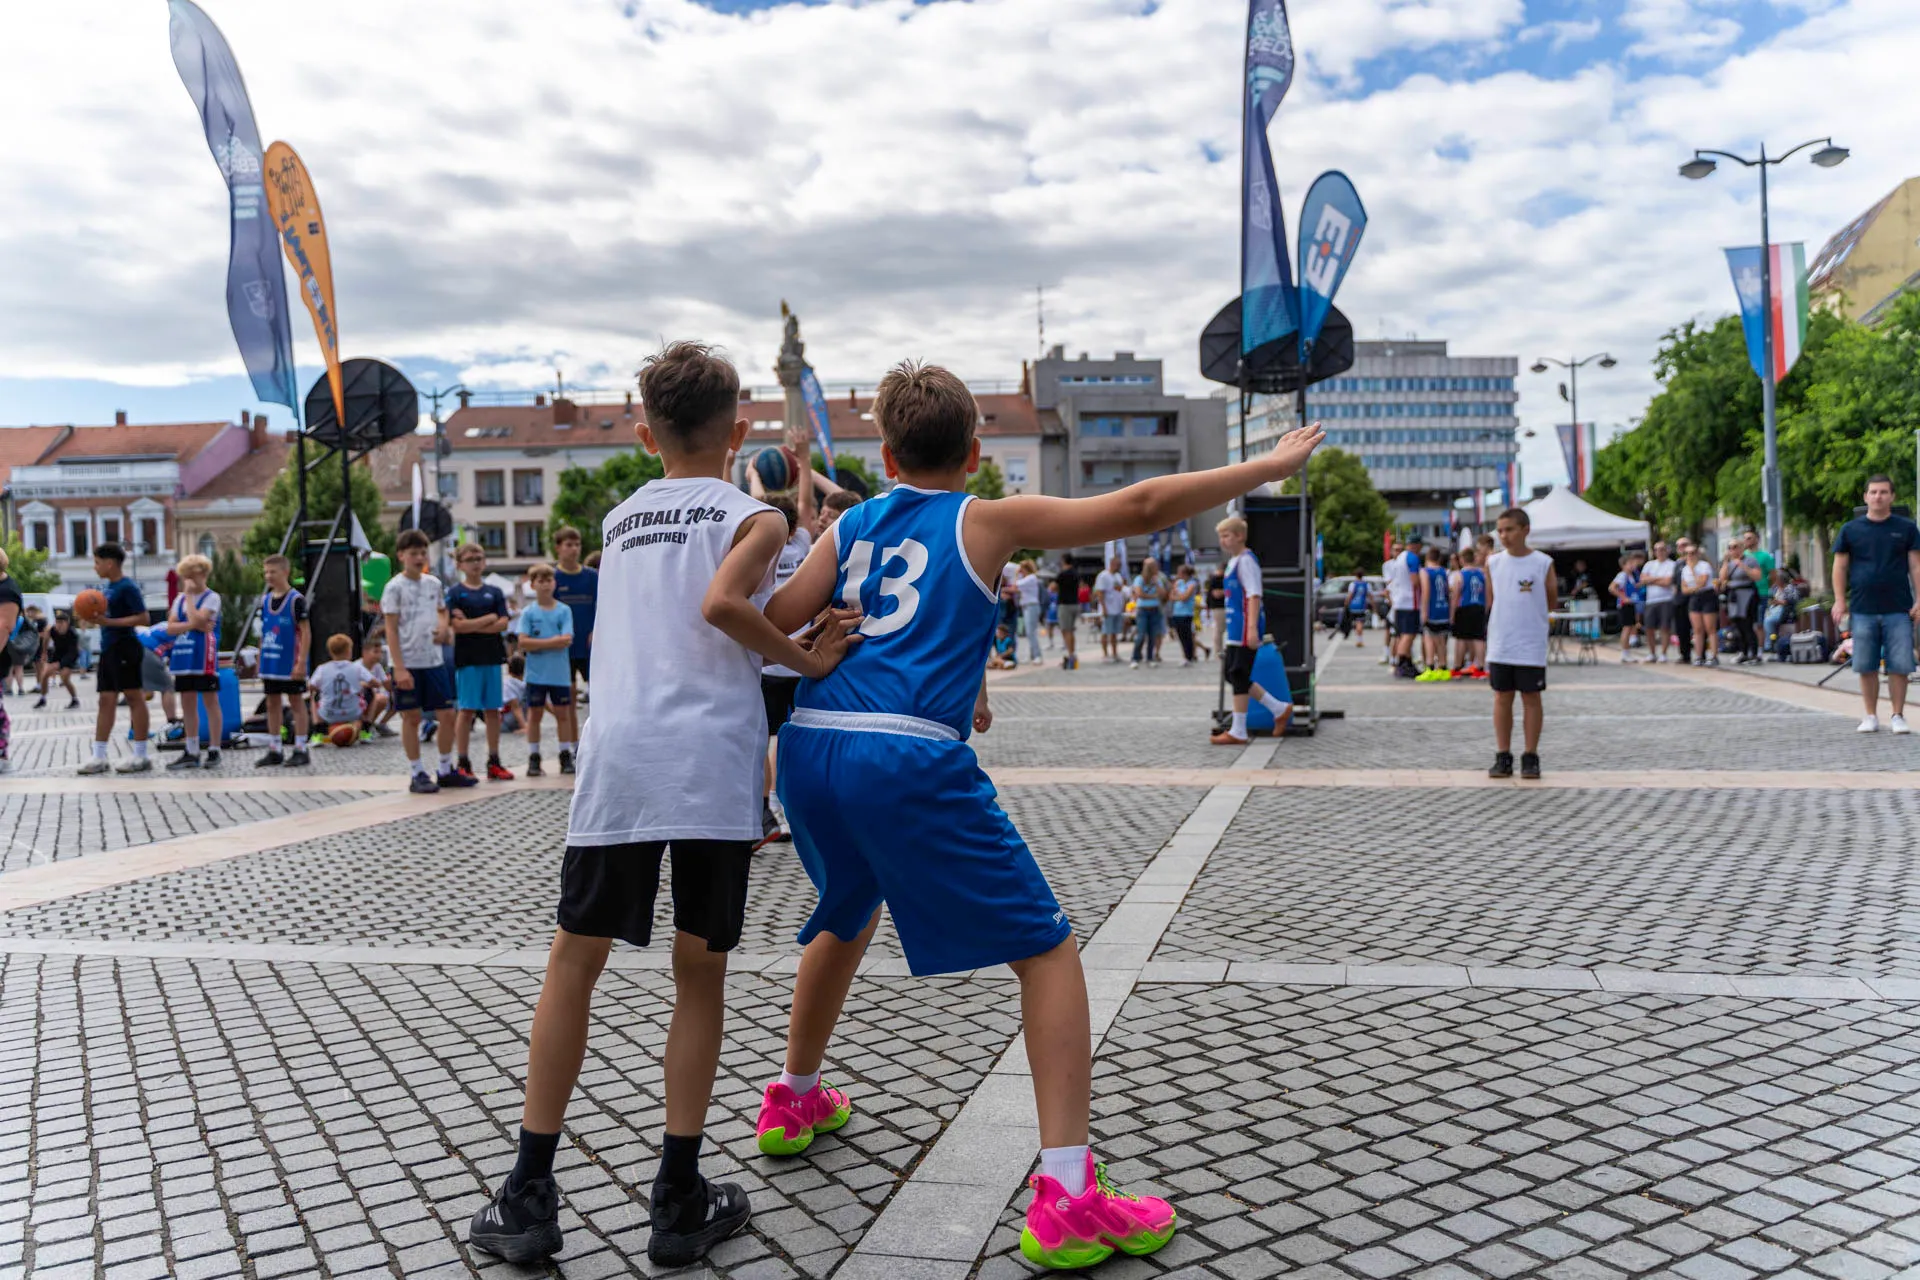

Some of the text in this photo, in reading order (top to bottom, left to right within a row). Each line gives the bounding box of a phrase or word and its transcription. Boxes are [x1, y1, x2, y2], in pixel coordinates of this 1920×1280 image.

[605, 506, 727, 547] STREETBALL 2026
[621, 531, 689, 552] SZOMBATHELY
[840, 538, 929, 637] 13
